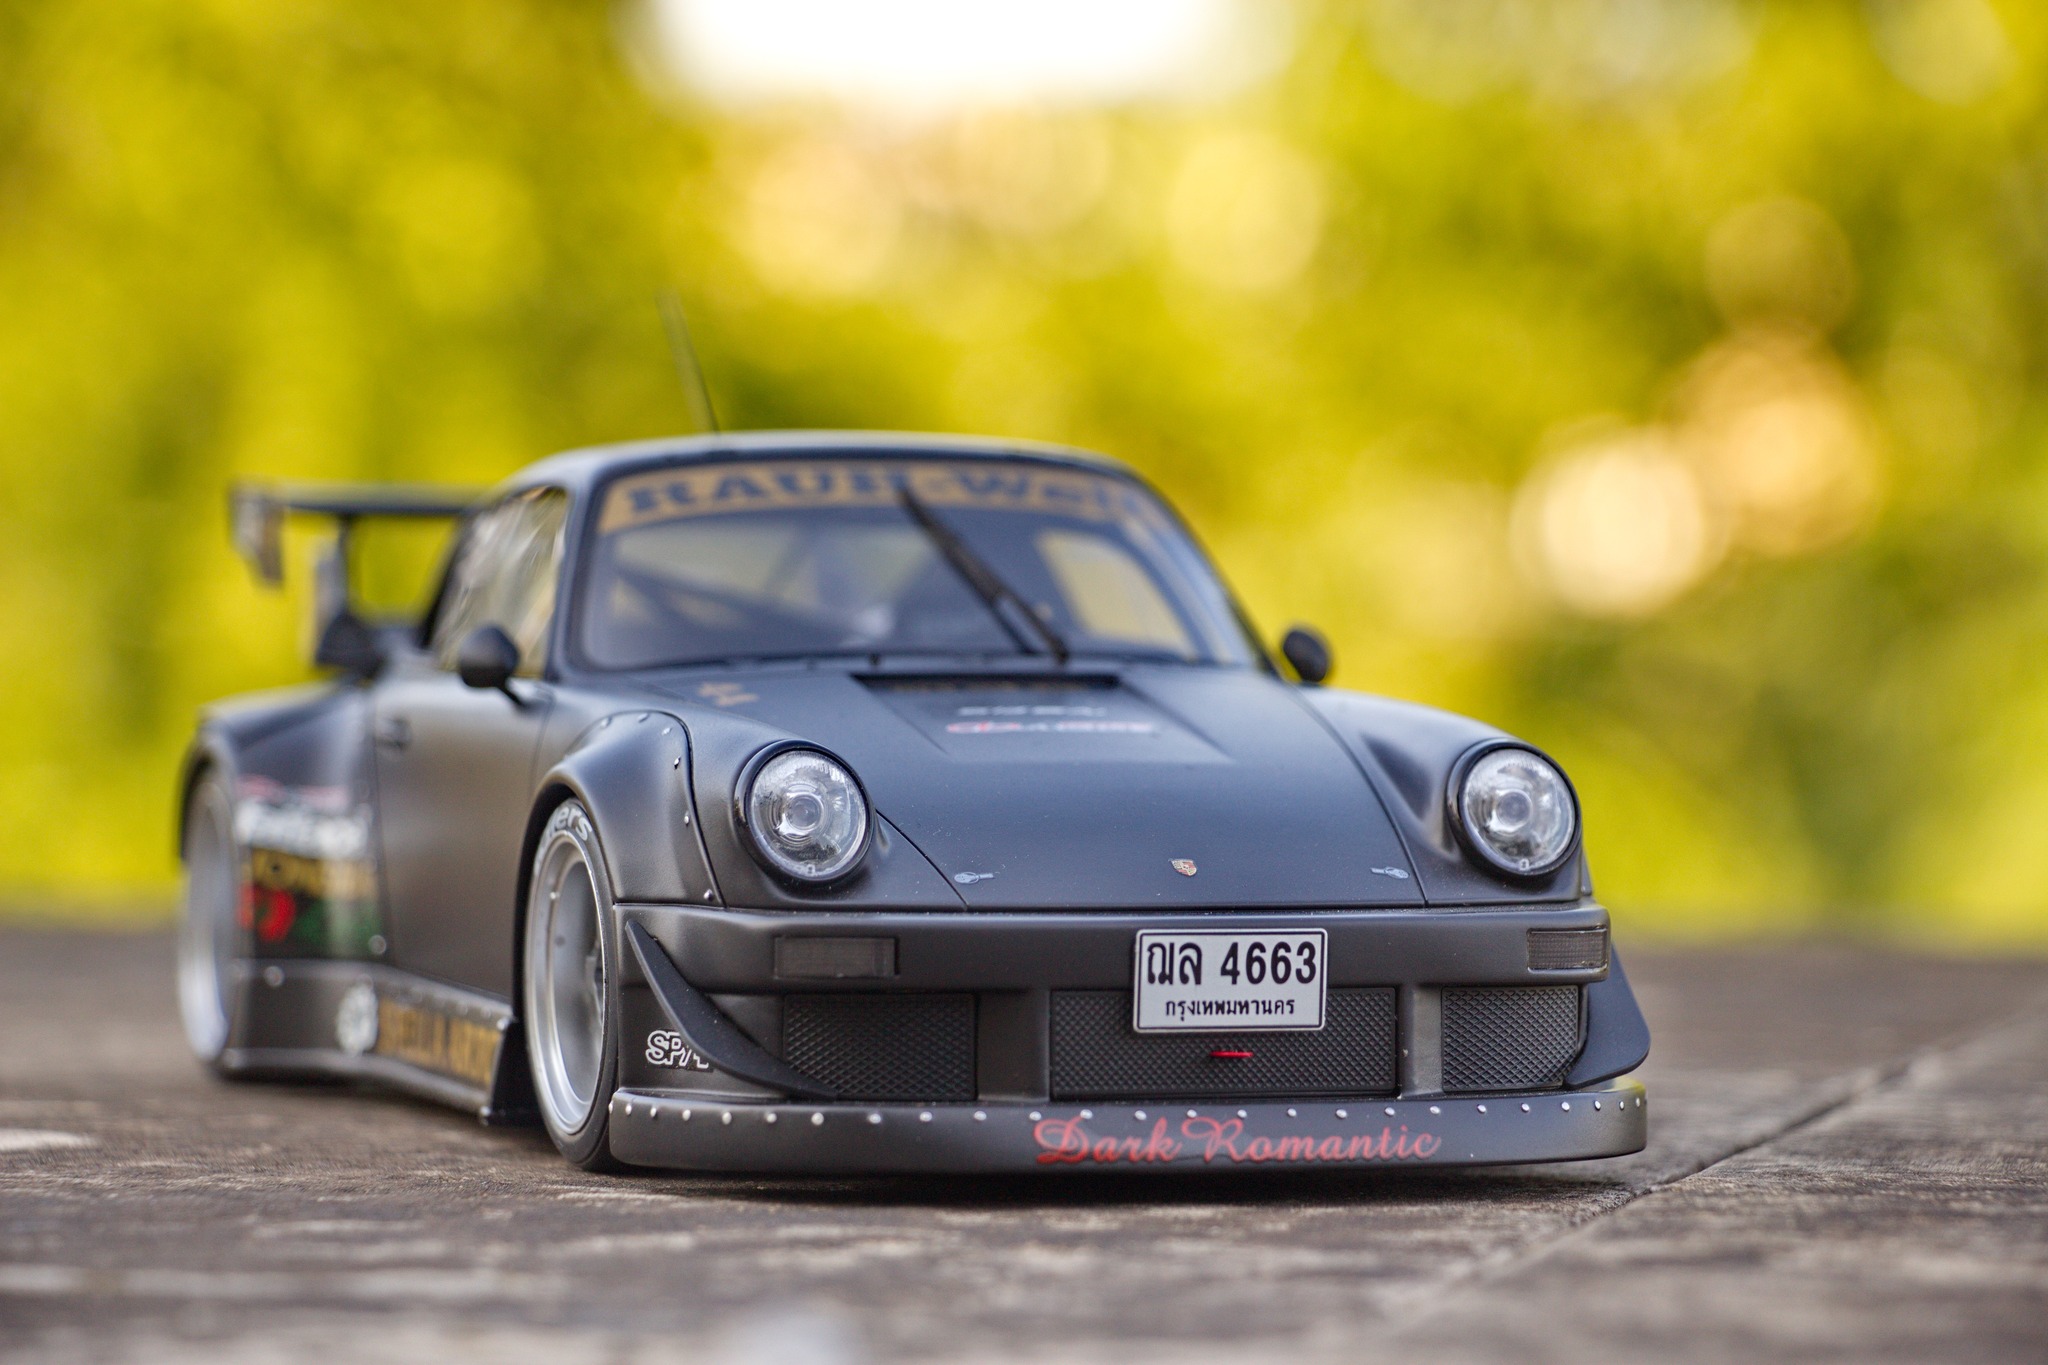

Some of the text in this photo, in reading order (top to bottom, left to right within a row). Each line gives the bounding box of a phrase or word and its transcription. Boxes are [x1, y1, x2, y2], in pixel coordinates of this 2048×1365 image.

[1147, 941, 1317, 985] ฌล 4663
[1165, 999, 1295, 1022] กรุงเทพมหานคร
[1034, 1115, 1442, 1164] Dark Romantic
